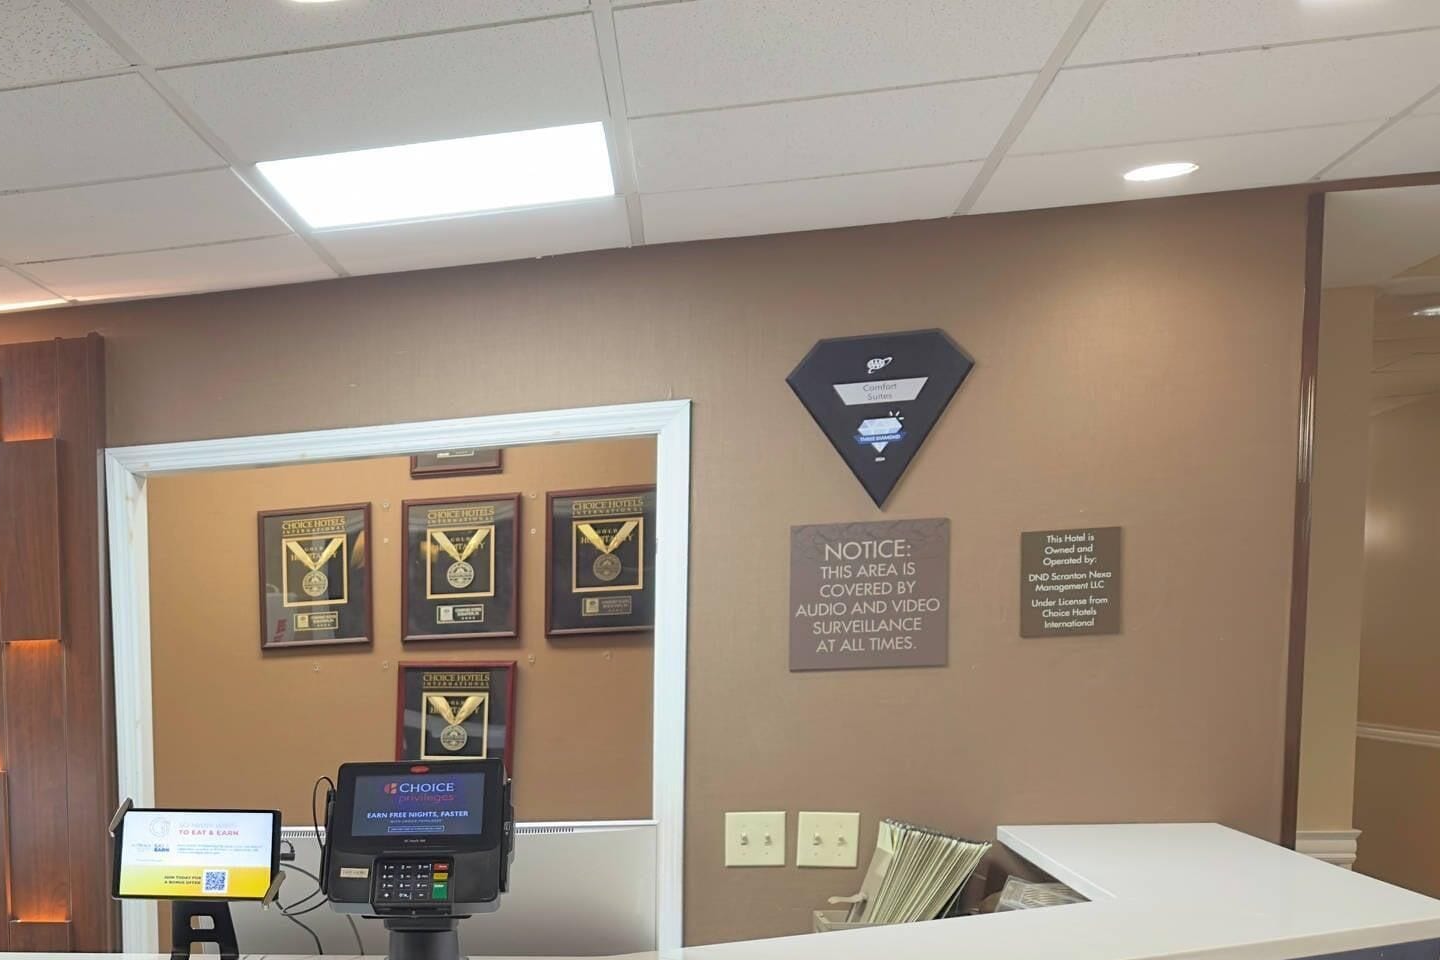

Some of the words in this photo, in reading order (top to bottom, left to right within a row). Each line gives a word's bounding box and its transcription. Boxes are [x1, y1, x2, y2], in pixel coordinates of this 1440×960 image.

[863, 383, 897, 392] Comfort
[572, 502, 607, 510] CHOICE
[428, 511, 461, 519] CHOICE
[462, 508, 495, 517] HOTELS
[282, 521, 313, 530] CHOICE
[315, 518, 345, 527] HOTELS
[1046, 535, 1062, 543] This
[1064, 532, 1085, 542] Hotel
[825, 539, 911, 560] NOTICE:
[1044, 544, 1074, 554] Owned
[1077, 544, 1093, 552] and
[1043, 555, 1081, 567] Operated
[1084, 555, 1096, 565] by:
[820, 565, 852, 579] THIS
[856, 564, 898, 577] AREA
[903, 562, 916, 575] IS
[1029, 573, 1049, 582] DND
[820, 582, 892, 597] COVERED
[897, 581, 916, 594] BY
[1035, 582, 1088, 592] Management
[1090, 580, 1104, 589] LLC
[1032, 598, 1056, 607] Under
[1058, 598, 1087, 606] License
[1089, 596, 1108, 604] from
[795, 602, 847, 618] AUDIO
[851, 600, 887, 615] AND
[892, 598, 940, 613] VIDEO
[1042, 609, 1070, 617] Choice
[1072, 607, 1097, 616] Hotels
[813, 617, 922, 635] SURVEILLANCE
[1044, 617, 1094, 628] International
[816, 640, 836, 652] AT
[840, 638, 865, 651] ALL
[869, 636, 917, 650] TIMES.
[400, 783, 455, 792] CHOICE
